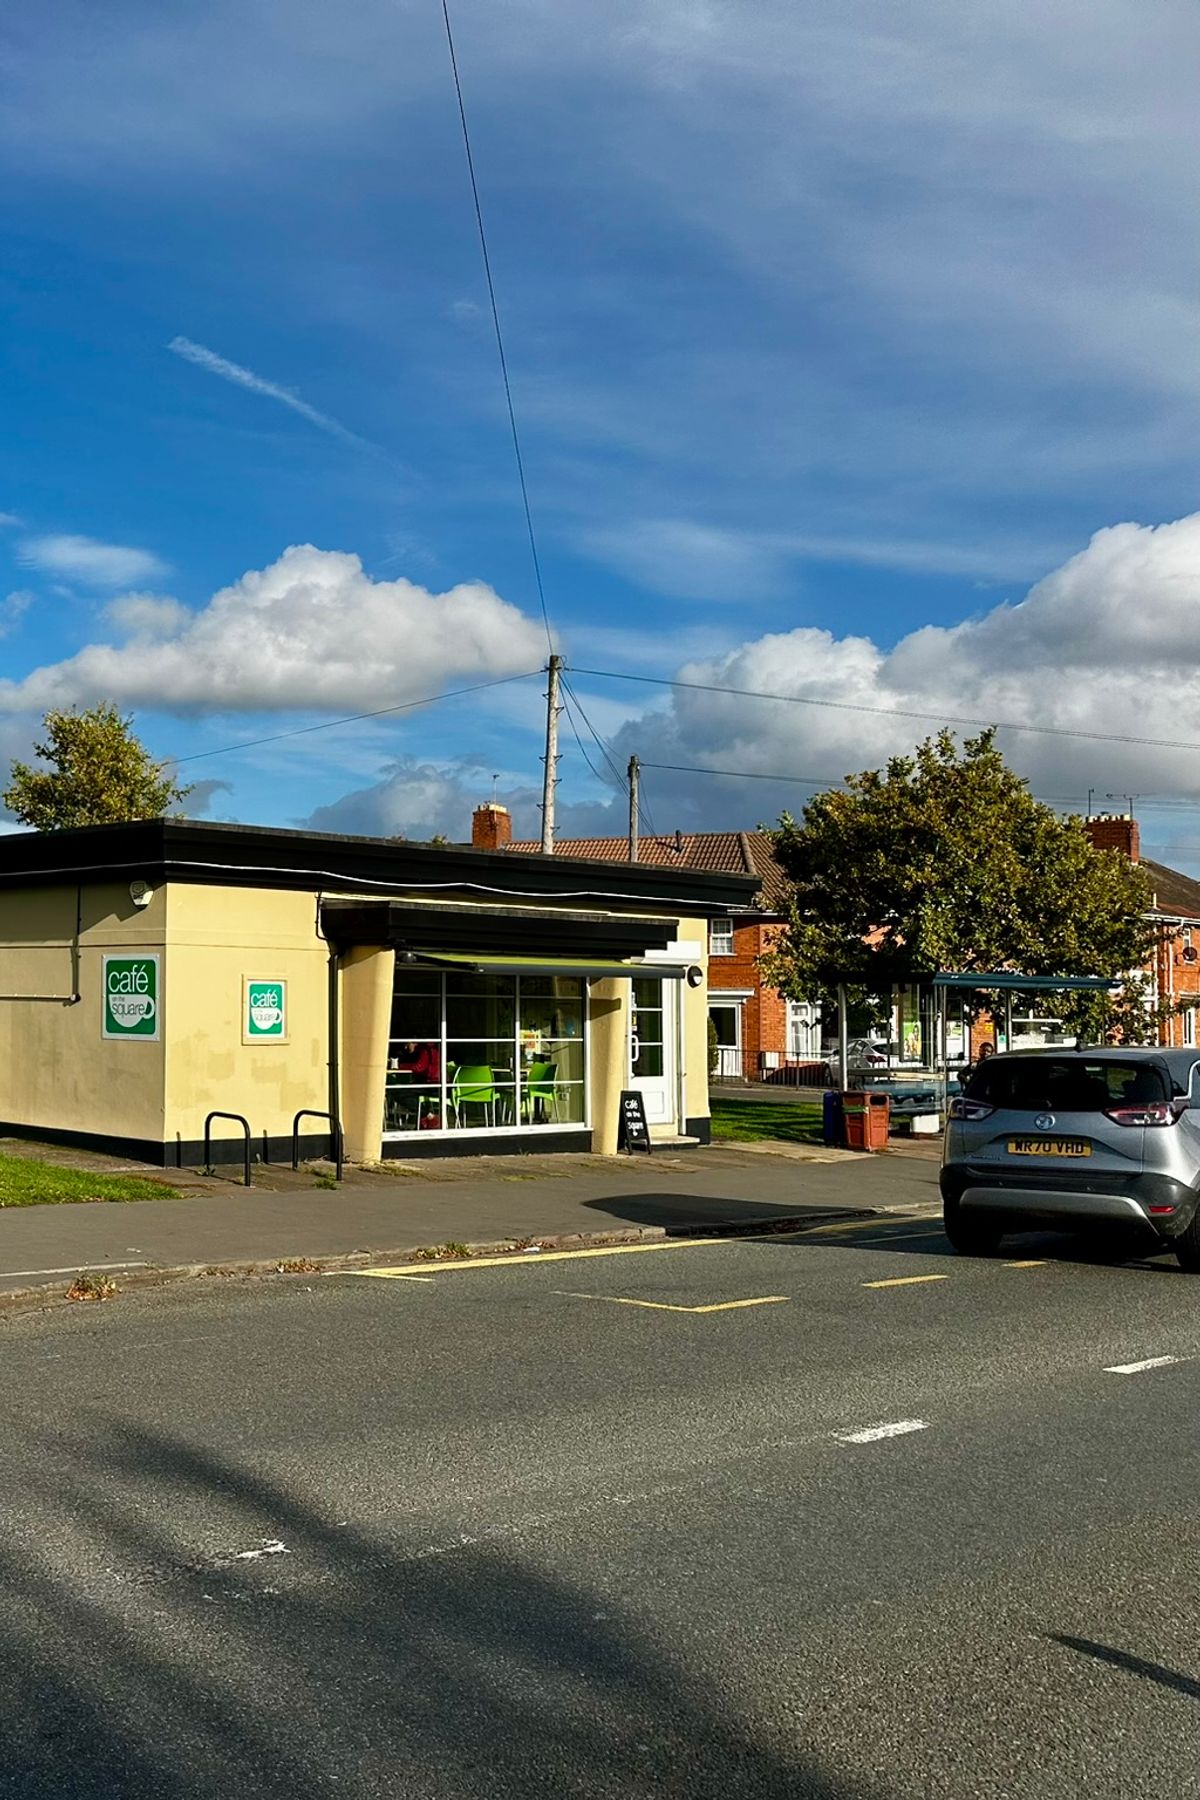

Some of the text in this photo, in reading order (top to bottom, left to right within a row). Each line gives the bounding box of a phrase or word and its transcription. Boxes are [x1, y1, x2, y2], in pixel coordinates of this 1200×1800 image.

[108, 964, 149, 993] café
[251, 989, 278, 1007] café
[111, 1003, 146, 1018] square
[1015, 1140, 1085, 1154] WR70 VHD
